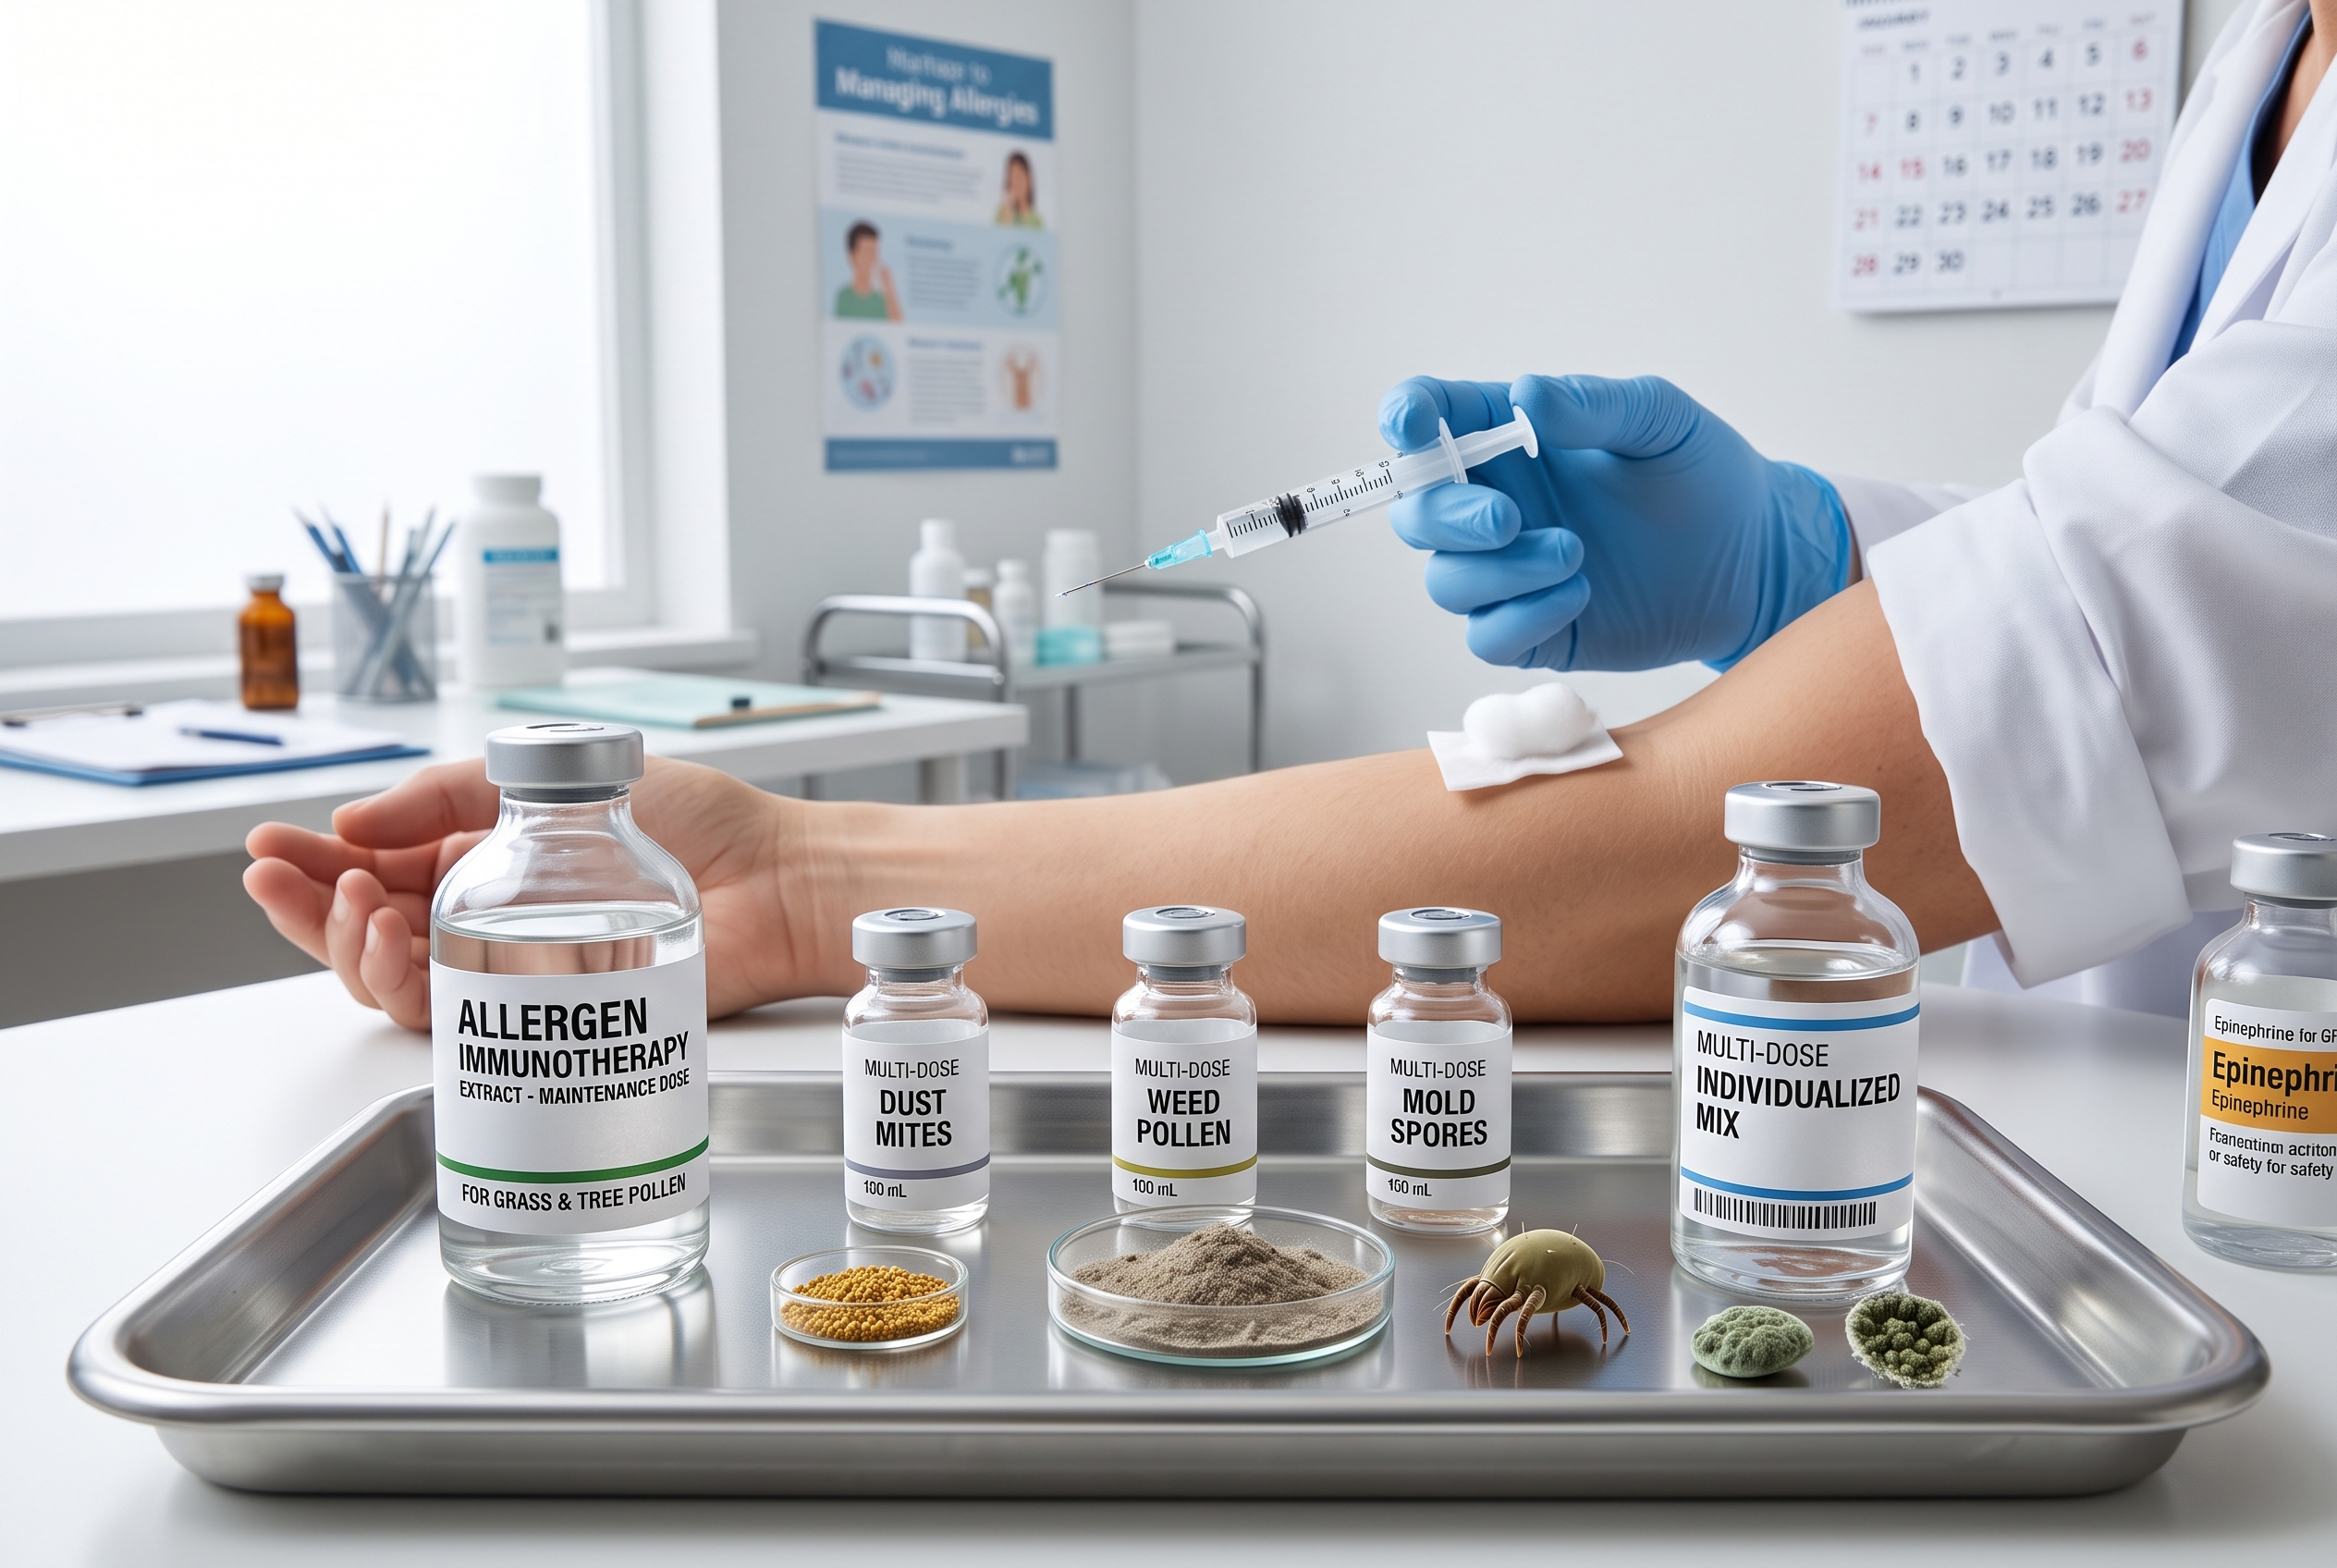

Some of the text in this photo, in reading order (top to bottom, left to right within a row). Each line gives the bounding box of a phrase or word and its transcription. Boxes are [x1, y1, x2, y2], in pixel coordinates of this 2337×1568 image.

[1911, 39, 2148, 82] 1 2 3 4 5 6
[836, 67, 1039, 127] Managing Allergies
[1865, 89, 2151, 134] 7 8 9 10 11 12 13
[1858, 138, 2151, 181] 14 15 16 17 18 19 20
[1854, 190, 2147, 229] 21 22 23 24 25 26 27
[1853, 250, 1964, 276] 28 29 30
[458, 997, 647, 1042] ALLERGEN
[2214, 1015, 2294, 1042] Epinephrine
[2298, 1027, 2318, 1043] for
[459, 1030, 689, 1079] IMMUNOTHERAPY
[1697, 1029, 1829, 1068] MULTI-DOSE
[864, 1059, 960, 1079] MULTI-DOSE
[1135, 1058, 1230, 1079] MULTI-DOSE
[1390, 1058, 1487, 1079] MULTI-DOSE
[459, 1079, 523, 1105] EXTRACT
[539, 1077, 656, 1105] MAINTENANCE
[659, 1067, 690, 1093] DOSE
[1403, 1087, 1475, 1116] MOLD
[1696, 1064, 1901, 1109] INDIVIDUALIZED
[880, 1088, 947, 1117] DUST
[1146, 1088, 1220, 1116] WEED
[2211, 1088, 2309, 1121] Epinephrine
[875, 1120, 952, 1148] MITES
[1137, 1118, 1230, 1147] POLLEN
[1390, 1118, 1487, 1148] SPORES
[1696, 1102, 1740, 1139] MIX
[2209, 1149, 2334, 1181] or safety for safety
[462, 1172, 686, 1212] FOR GRASS & TREE POLLEN
[863, 1179, 908, 1198] 100 mL
[1132, 1178, 1179, 1197] 100 mL
[1413, 1182, 1432, 1197] mL
